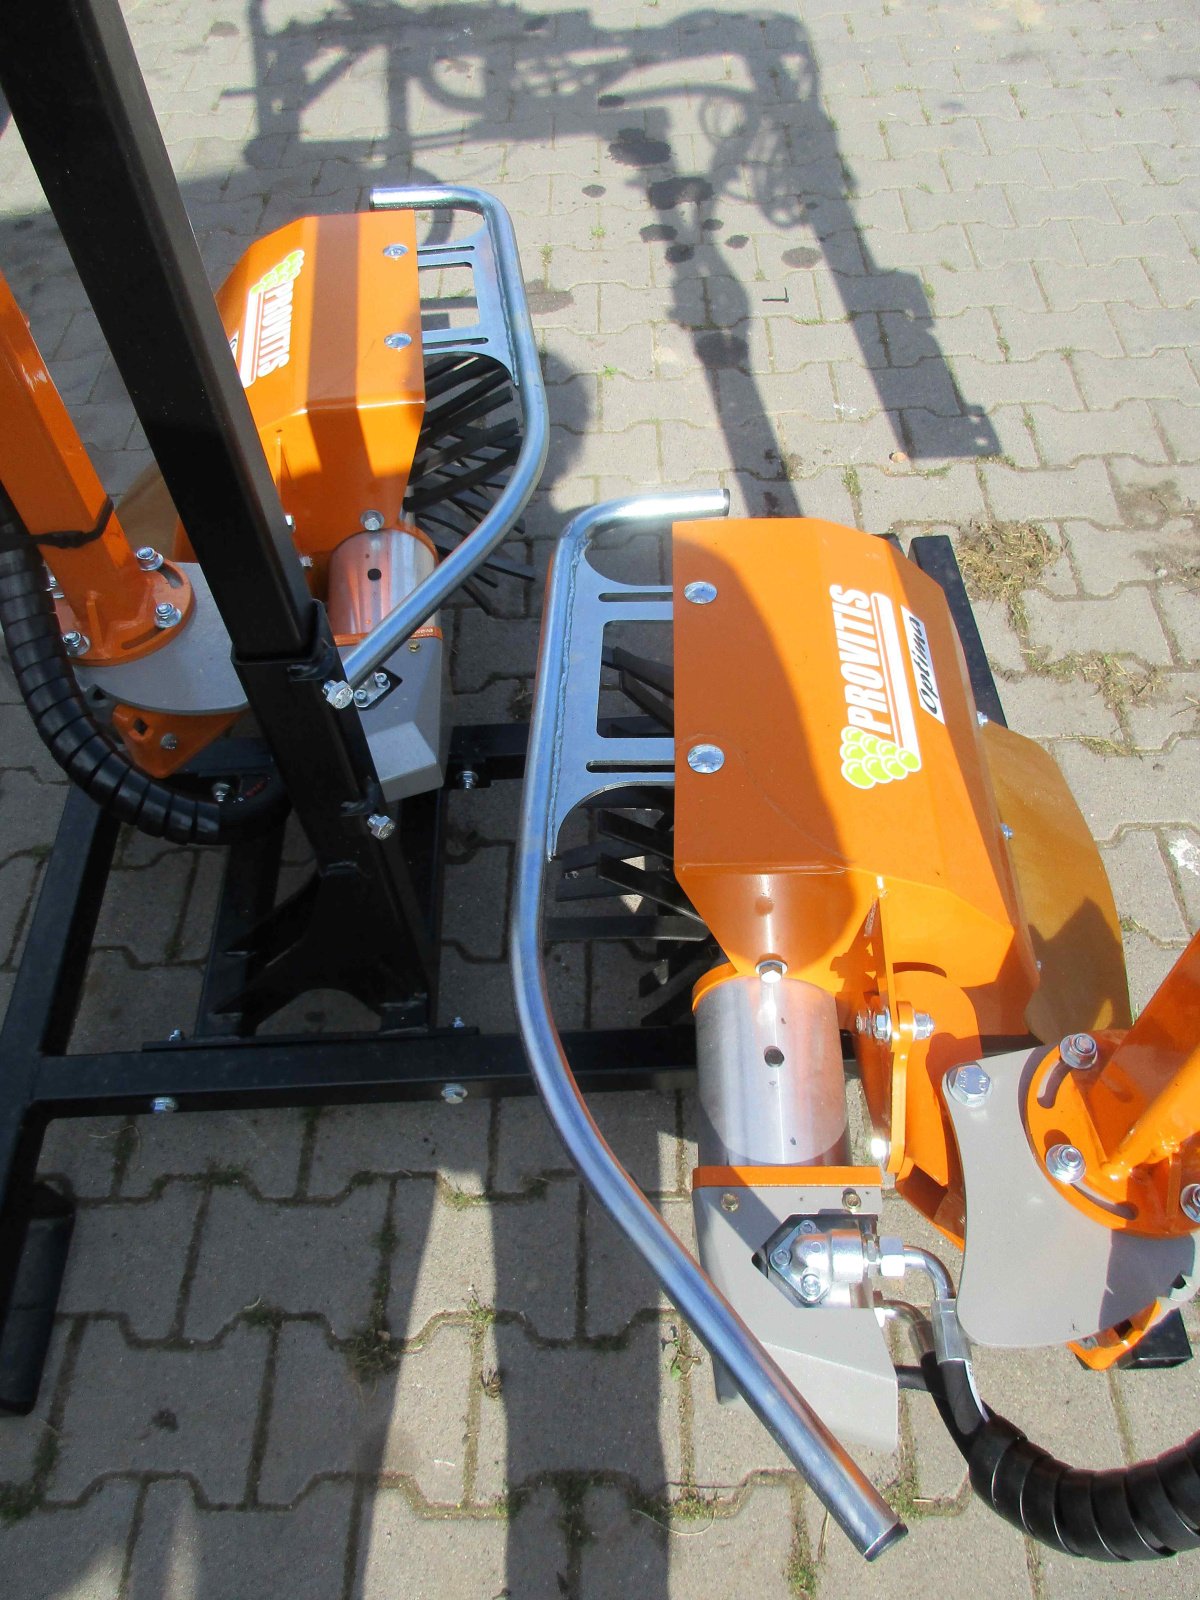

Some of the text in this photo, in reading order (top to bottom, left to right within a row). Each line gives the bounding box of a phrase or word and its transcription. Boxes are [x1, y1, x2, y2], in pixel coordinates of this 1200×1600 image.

[257, 279, 295, 378] PROVITIS
[829, 584, 892, 735] PROVITIS
[908, 615, 939, 715] Optima
